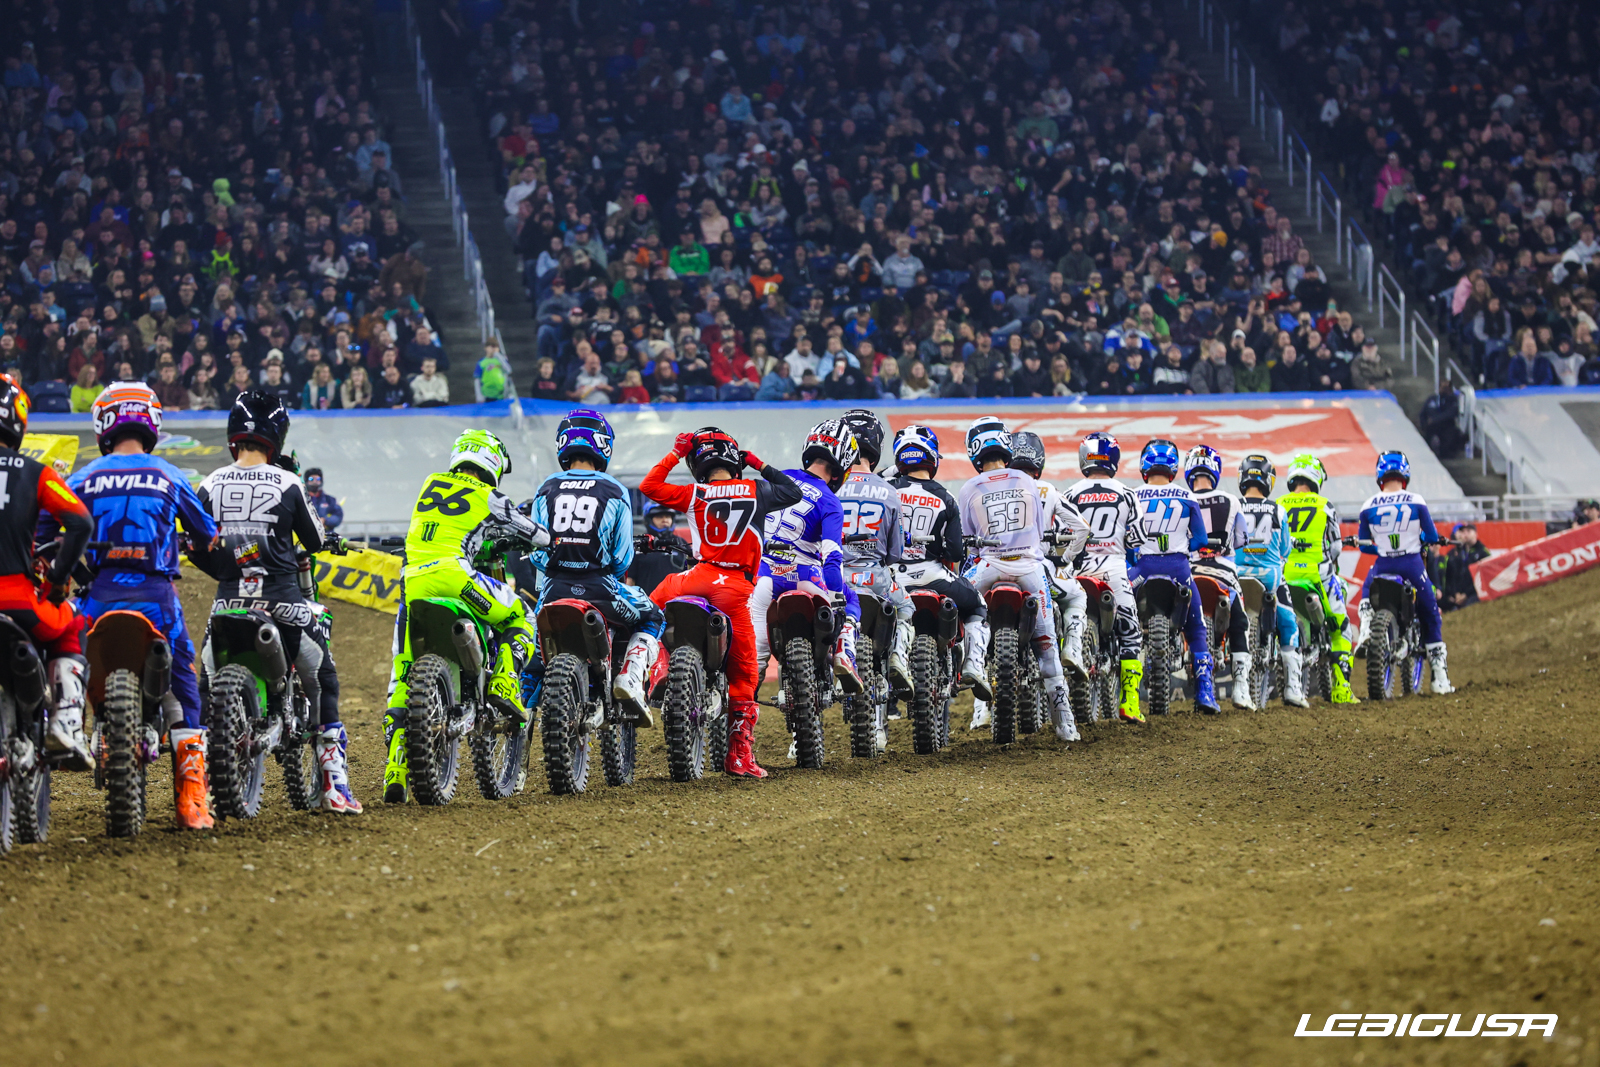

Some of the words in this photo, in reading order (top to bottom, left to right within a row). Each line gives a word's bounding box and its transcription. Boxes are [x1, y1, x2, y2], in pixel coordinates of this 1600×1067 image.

[807, 434, 840, 447] HENRY
[900, 450, 924, 460] CARSON
[84, 474, 170, 494] LINVILLE
[212, 471, 282, 485] CHAMBERS
[559, 480, 596, 490] COLIP
[417, 480, 476, 516] 56
[703, 484, 751, 499] MUNOZ
[839, 483, 889, 500] HLAND
[982, 489, 1025, 504] PARK
[1078, 493, 1118, 504] HYMAS
[1370, 493, 1414, 507] ANSTIE
[208, 483, 283, 524] 192
[92, 495, 165, 543] 75
[552, 494, 599, 533] 89
[704, 498, 757, 547] 87
[987, 500, 1027, 535] 59
[1287, 506, 1318, 532] 47
[1372, 503, 1413, 534] 31
[227, 526, 276, 538] PARTZILLA
[314, 561, 402, 603] DUN
